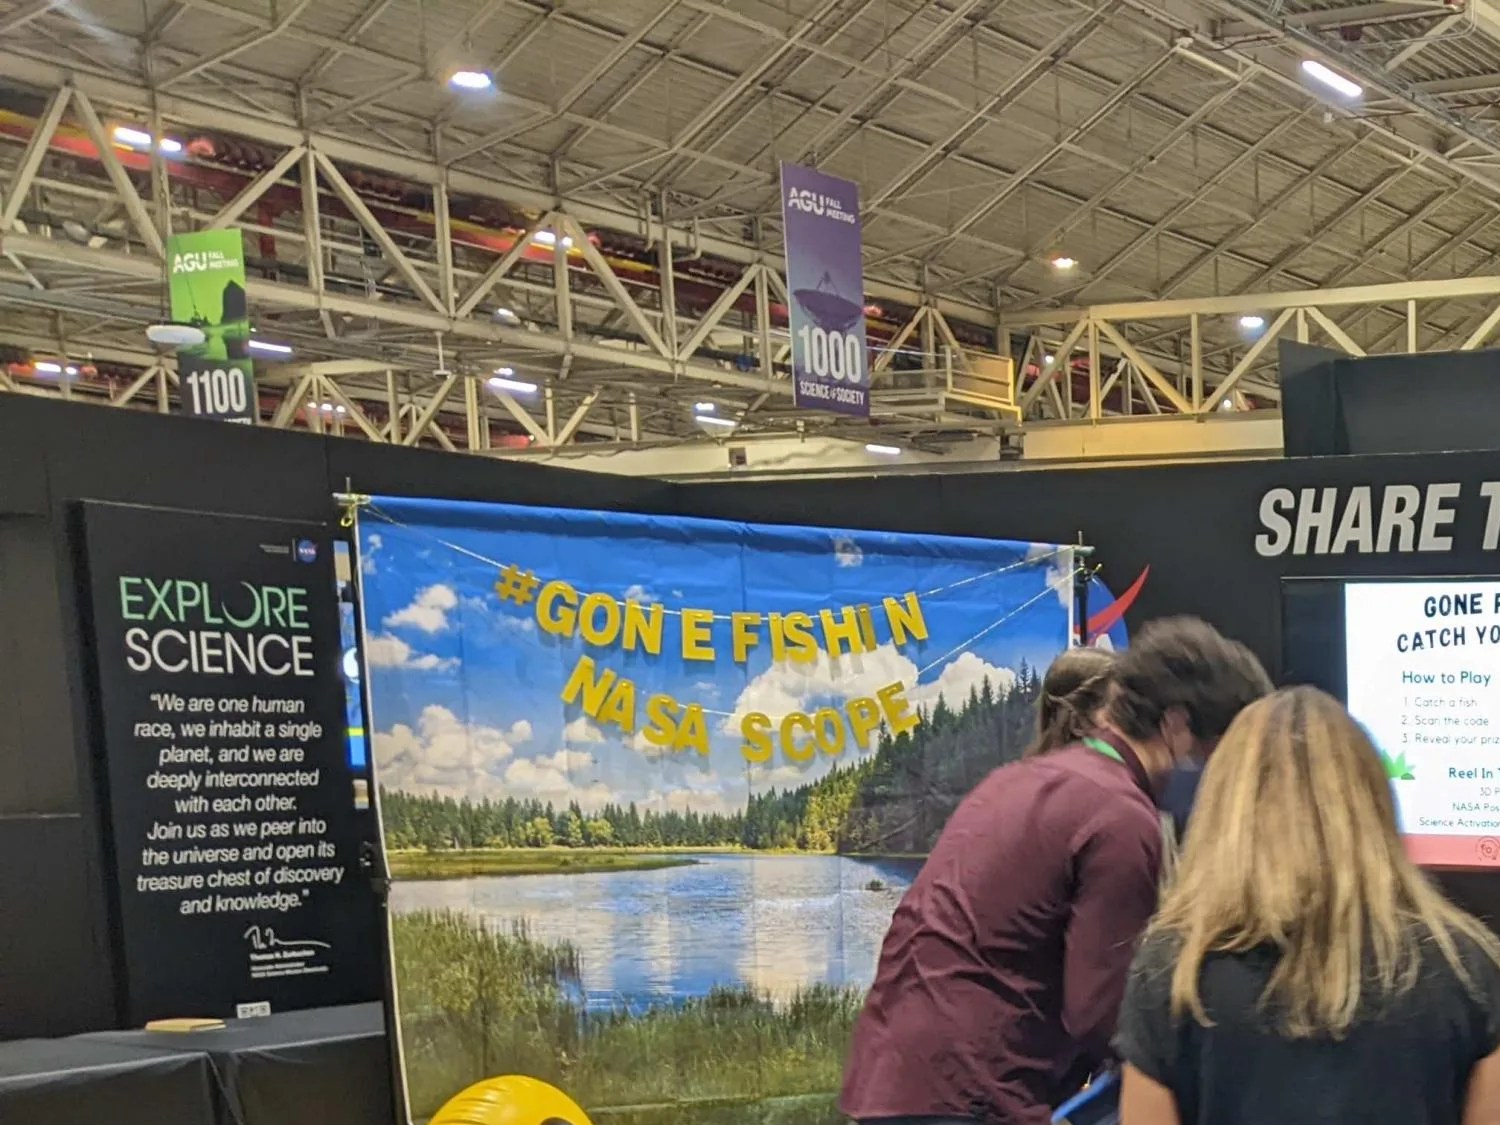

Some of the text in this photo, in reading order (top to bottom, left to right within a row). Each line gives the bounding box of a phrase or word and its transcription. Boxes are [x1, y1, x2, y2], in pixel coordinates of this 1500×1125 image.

[788, 186, 825, 215] AGU
[825, 197, 842, 210] FALL
[173, 252, 207, 273] AGU
[798, 325, 861, 383] 1000
[186, 367, 247, 415] 1100
[800, 380, 830, 400] SCIENCE
[836, 387, 865, 405] SOCIETY
[1254, 482, 1461, 556] SHARE
[119, 576, 310, 629] EXPLORE
[1424, 593, 1483, 618] GONE
[1397, 626, 1466, 653] CATCH
[125, 627, 315, 677] SCIENCE
[1402, 671, 1491, 687] How to Play
[188, 698, 214, 712] are
[218, 698, 249, 713] one
[252, 695, 305, 713] human
[561, 654, 921, 764] NASA SCOPE
[1414, 696, 1445, 707] Catch
[1448, 699, 1456, 708] a
[1459, 696, 1478, 708] fish
[134, 719, 322, 742] race, we inhabit a single
[1414, 714, 1440, 726] Scan
[1444, 714, 1460, 726] the
[1463, 714, 1489, 727] code
[1415, 732, 1451, 744] Reveal
[1455, 735, 1476, 747] your
[159, 745, 305, 767] planet, and we are
[147, 769, 320, 791] deeply interconnected
[1448, 767, 1477, 779] Reel
[1482, 768, 1493, 779] In
[174, 794, 298, 813] with each other.
[1452, 802, 1480, 812] NASA
[147, 818, 327, 840] Join us as we peer into
[1419, 817, 1454, 828] Science
[142, 840, 336, 866] the universe and open its
[137, 866, 345, 891] treasure chest of discovery
[180, 895, 212, 914] and
